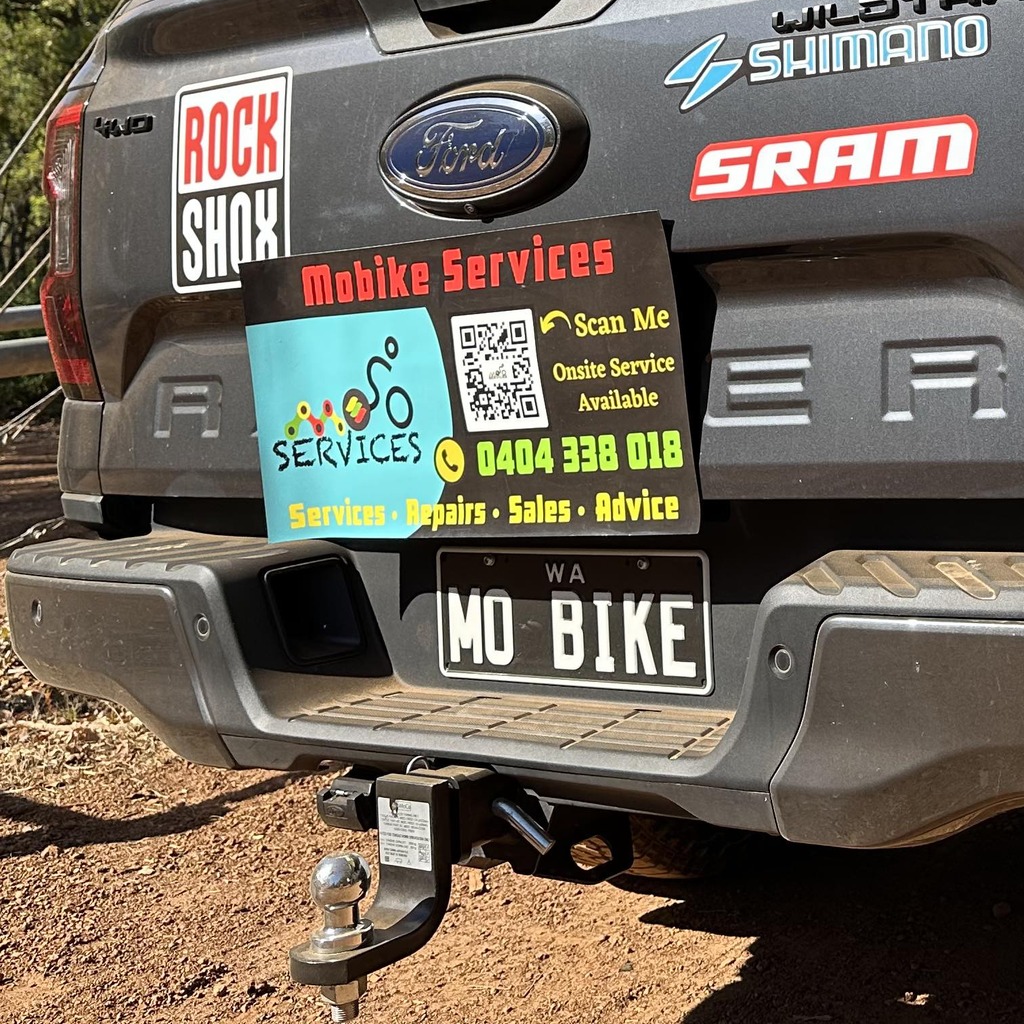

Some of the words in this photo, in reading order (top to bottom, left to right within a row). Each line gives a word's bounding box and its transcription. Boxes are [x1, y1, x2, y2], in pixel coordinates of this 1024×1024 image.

[748, 15, 989, 82] SHIMANO
[94, 114, 157, 139] 4WD
[184, 91, 279, 185] ROCK
[415, 118, 507, 177] Ford
[696, 122, 972, 195] SRAM
[182, 187, 278, 282] SHOX
[302, 254, 429, 307] Mobike
[442, 234, 614, 292] Services
[574, 311, 627, 338] Scan
[633, 306, 671, 334] Me
[552, 360, 606, 383] Onsite
[609, 353, 675, 377] Service
[578, 387, 659, 413] Available
[272, 431, 422, 471] SERVICES
[476, 439, 554, 477] 0404
[562, 433, 619, 474] 338
[625, 430, 684, 470] 018
[288, 498, 385, 529] Services
[406, 495, 486, 532] Repairs
[508, 490, 571, 525] Sales
[595, 487, 679, 523] Advice
[545, 562, 585, 584] WA
[448, 587, 514, 666] MO
[551, 590, 697, 678] BIKE
